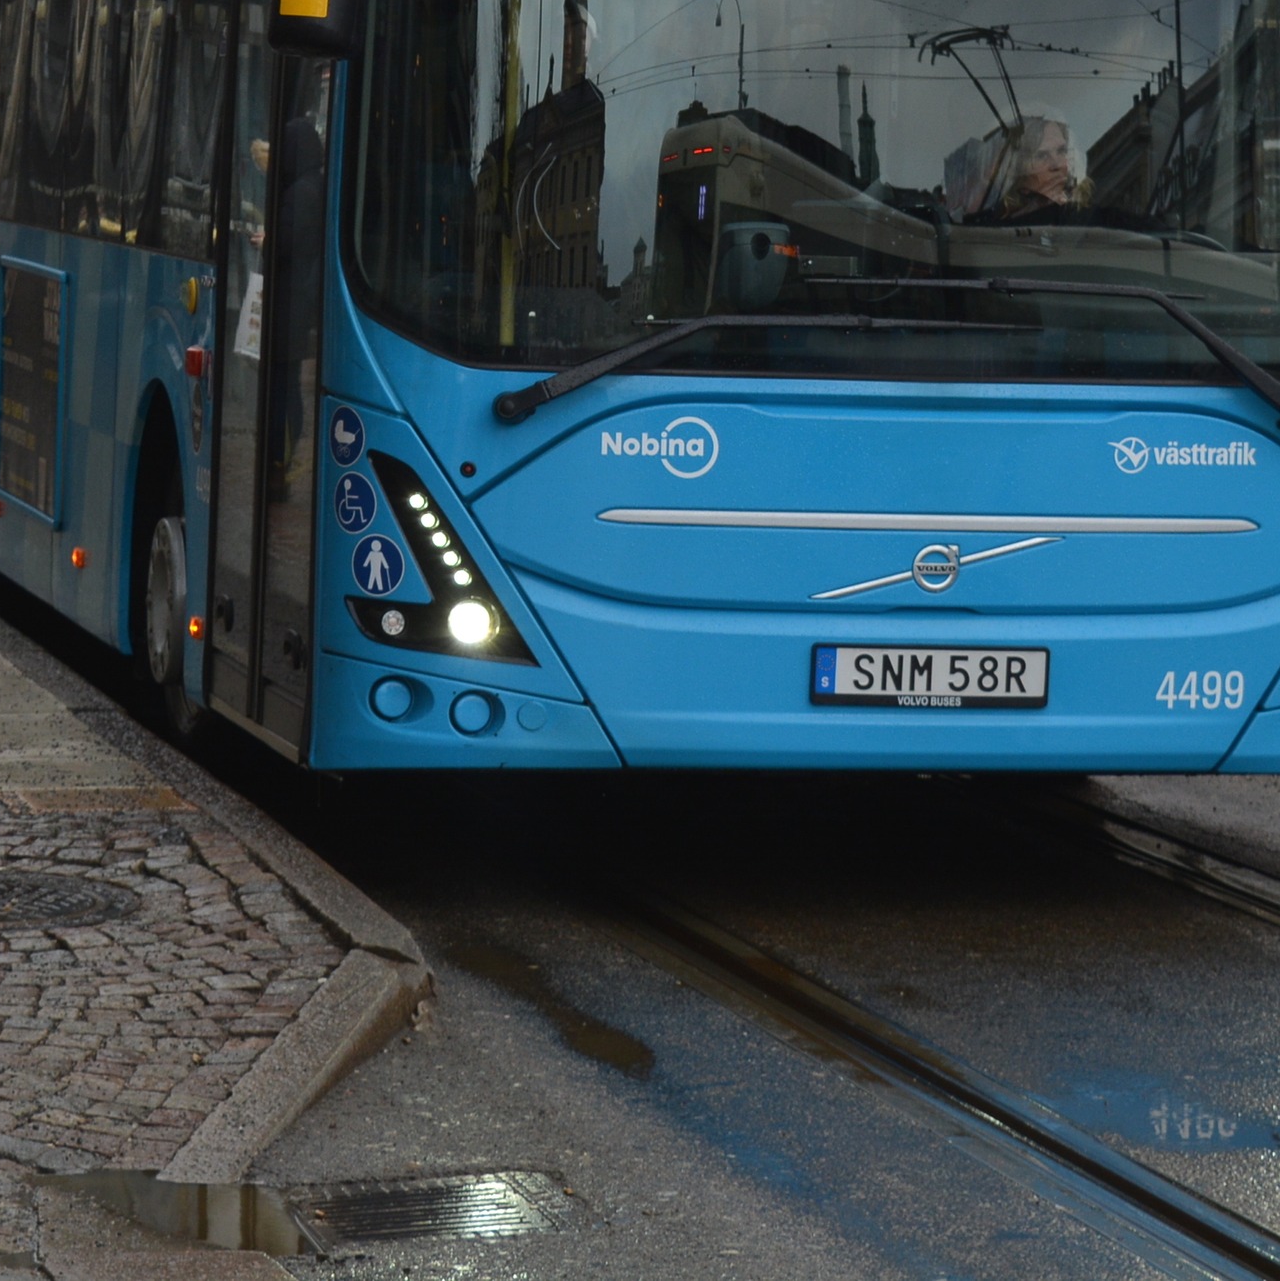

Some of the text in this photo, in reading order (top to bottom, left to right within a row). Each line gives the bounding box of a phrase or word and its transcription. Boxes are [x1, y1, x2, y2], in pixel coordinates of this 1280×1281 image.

[601, 431, 705, 457] Nobina
[1153, 441, 1257, 466] västtrafik
[916, 564, 957, 573] VOLVO
[821, 676, 830, 688] S
[852, 653, 1027, 694] SNM 58R
[897, 695, 962, 707] VOLVO BUSES
[1155, 670, 1245, 710] 4499
